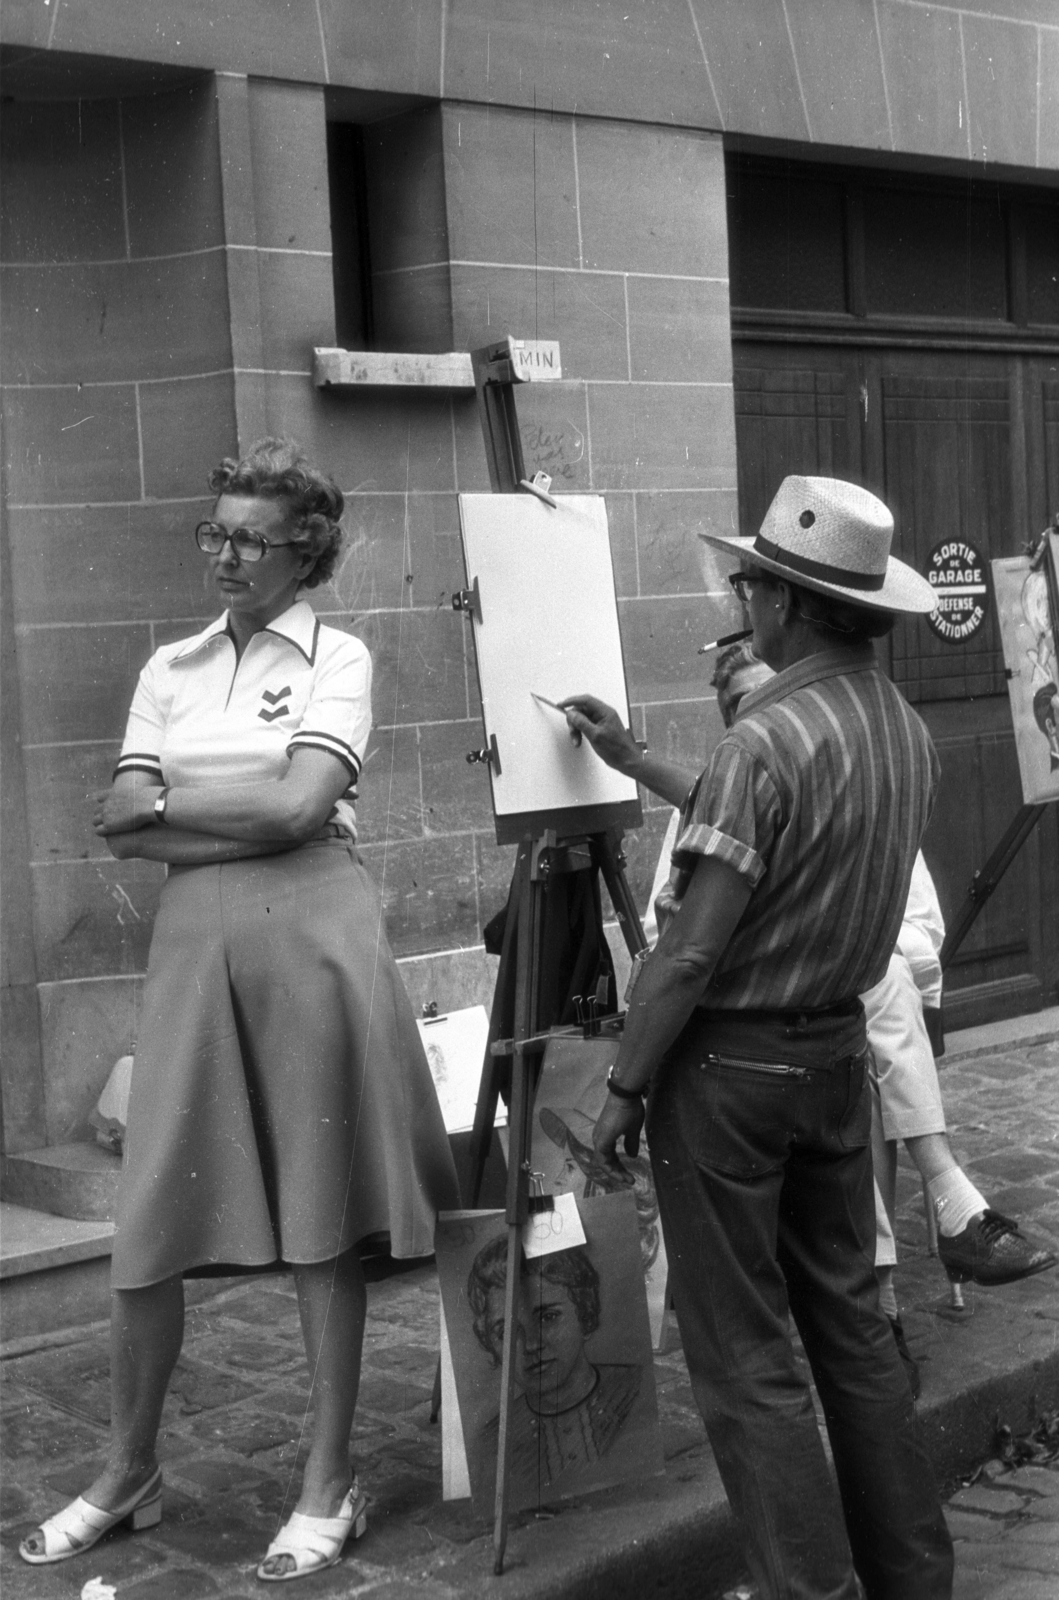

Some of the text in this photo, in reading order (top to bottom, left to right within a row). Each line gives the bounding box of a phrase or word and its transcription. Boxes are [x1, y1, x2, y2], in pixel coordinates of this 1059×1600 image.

[519, 351, 554, 369] MIN
[933, 542, 977, 567] SORTIE
[928, 569, 982, 584] GARAGE
[930, 606, 984, 638] STATIONNER
[951, 613, 962, 621] DE
